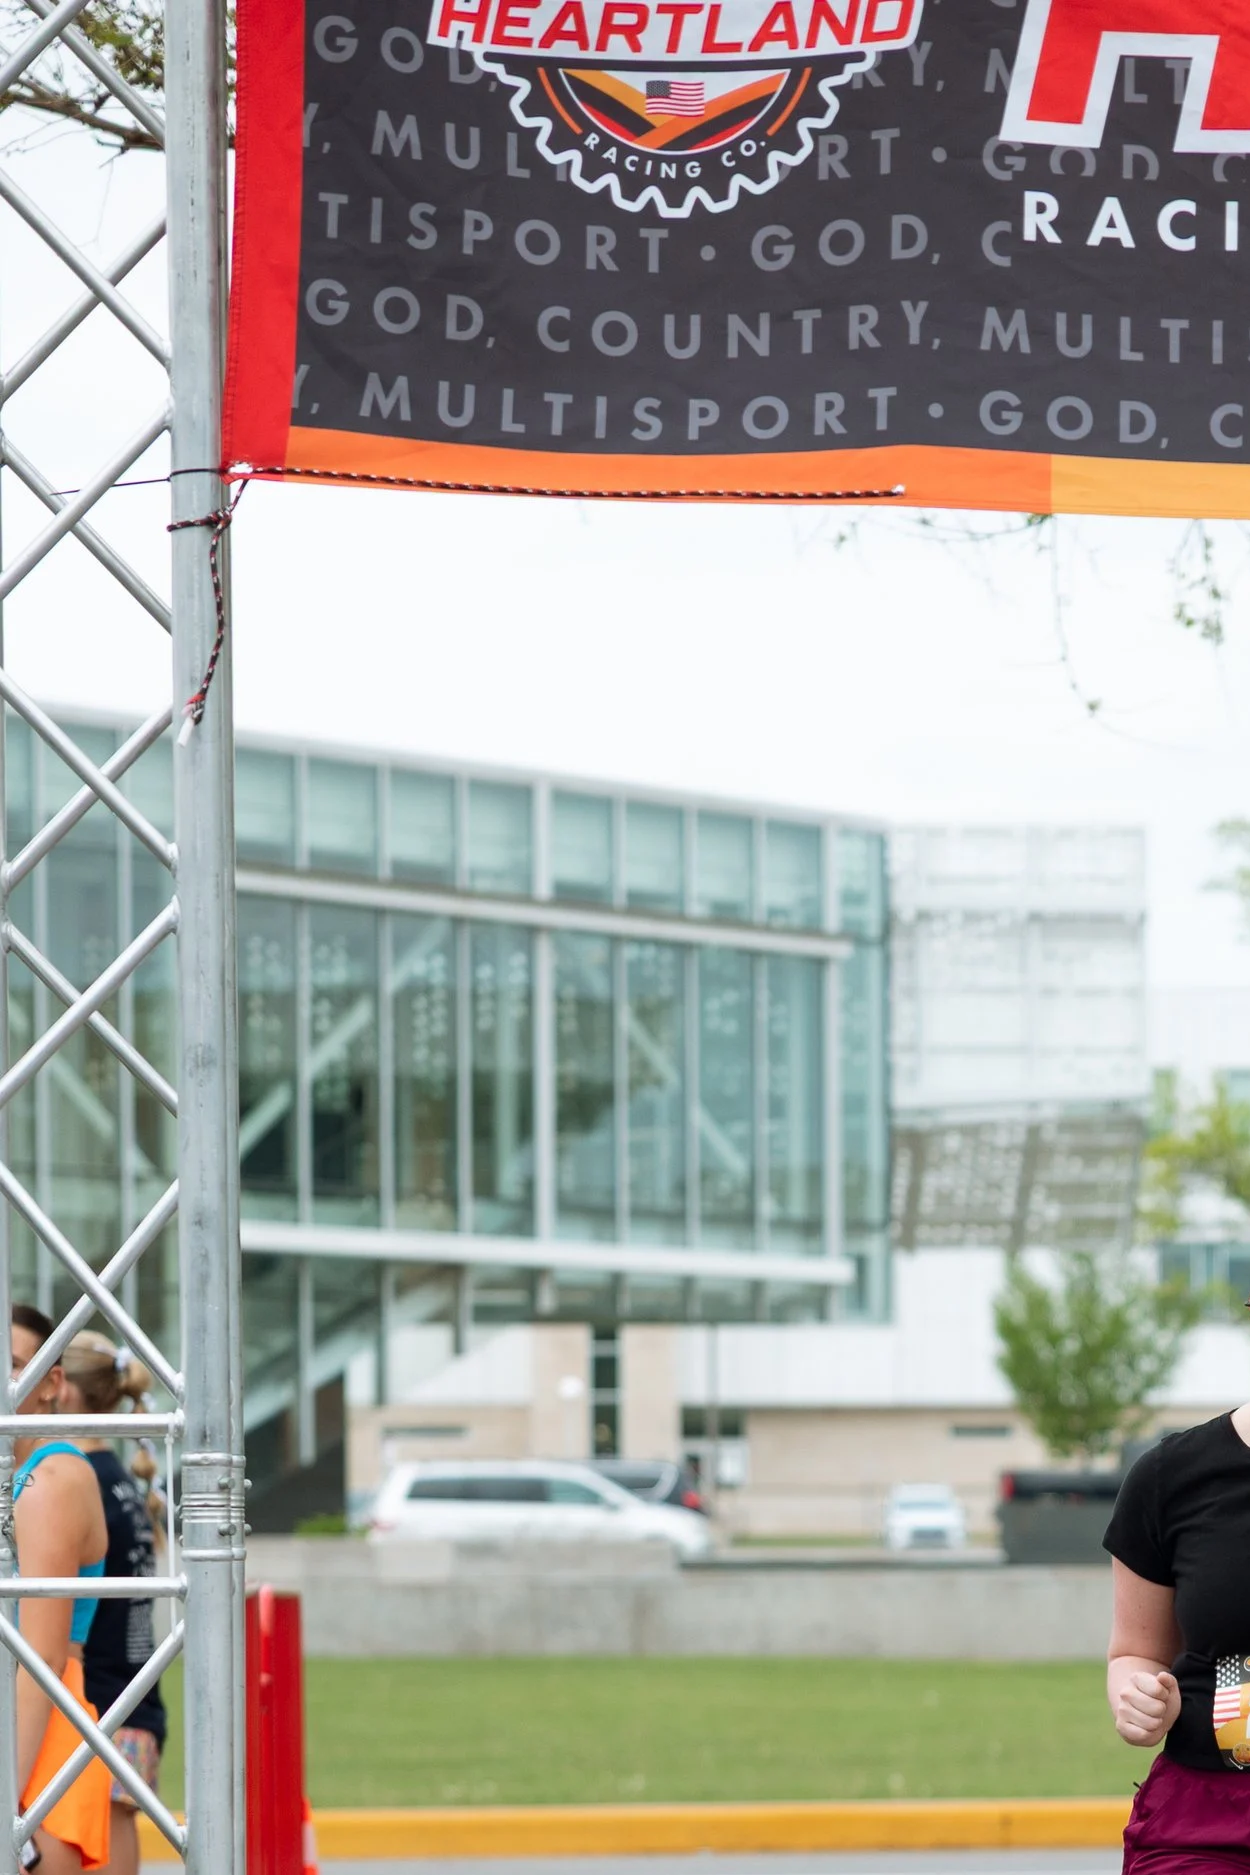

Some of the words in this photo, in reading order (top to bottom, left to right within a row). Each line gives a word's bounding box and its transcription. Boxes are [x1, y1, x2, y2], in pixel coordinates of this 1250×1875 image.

[437, 0, 906, 54] HEARTLAND
[584, 132, 702, 179] RACING
[721, 139, 767, 168] CO.
[318, 192, 670, 273] TISPORT
[751, 214, 940, 272] GOD,
[305, 278, 495, 349] GOD,
[537, 300, 941, 360] COUNTRY,
[359, 373, 898, 441] MULTISPORT
[979, 390, 1169, 449] GOD,
